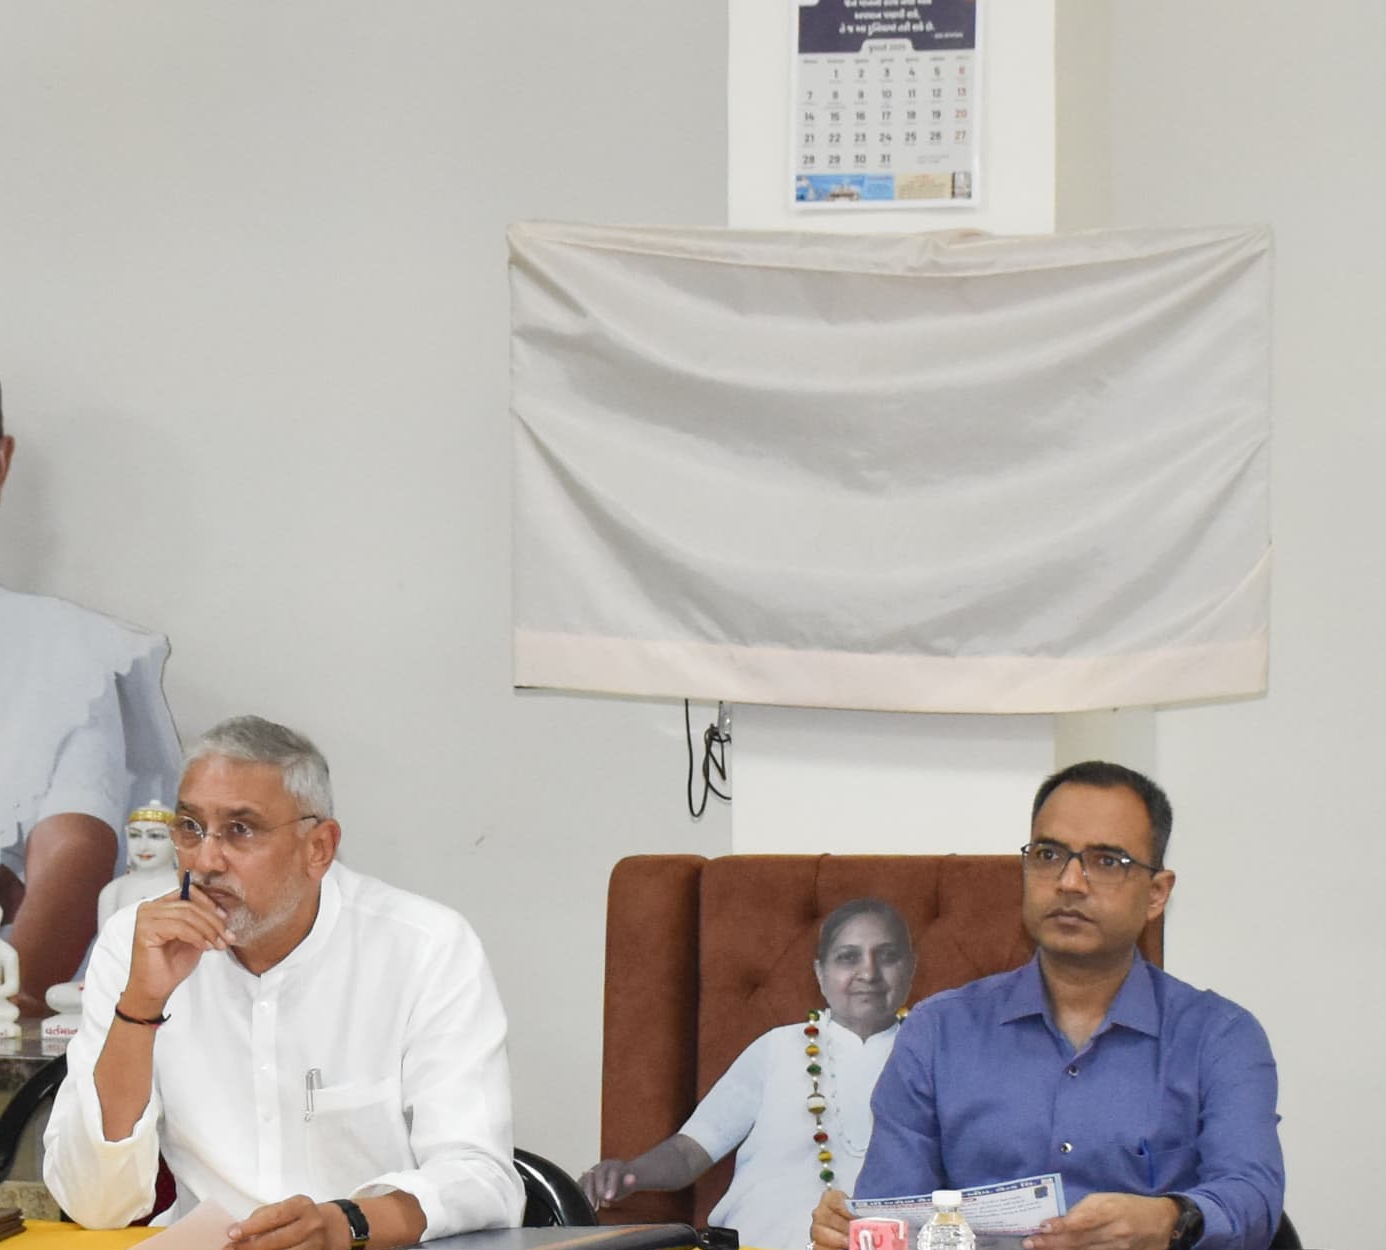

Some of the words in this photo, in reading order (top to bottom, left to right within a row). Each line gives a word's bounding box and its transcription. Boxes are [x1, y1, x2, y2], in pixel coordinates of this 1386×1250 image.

[882, 90, 892, 99] 10
[908, 89, 916, 98] 11
[933, 88, 941, 98] 12
[957, 88, 966, 96] 13
[805, 112, 814, 121] 14
[882, 111, 891, 120] 17
[933, 110, 941, 119] 19
[955, 109, 967, 119] 20
[805, 134, 814, 143] 21
[829, 133, 841, 143] 22
[855, 133, 866, 142] 23
[880, 133, 892, 142] 24
[905, 132, 916, 141] 25
[930, 132, 941, 140] 26
[955, 130, 966, 140] 27
[829, 155, 840, 164] 29
[855, 154, 866, 163] 30
[881, 154, 890, 163] 31
